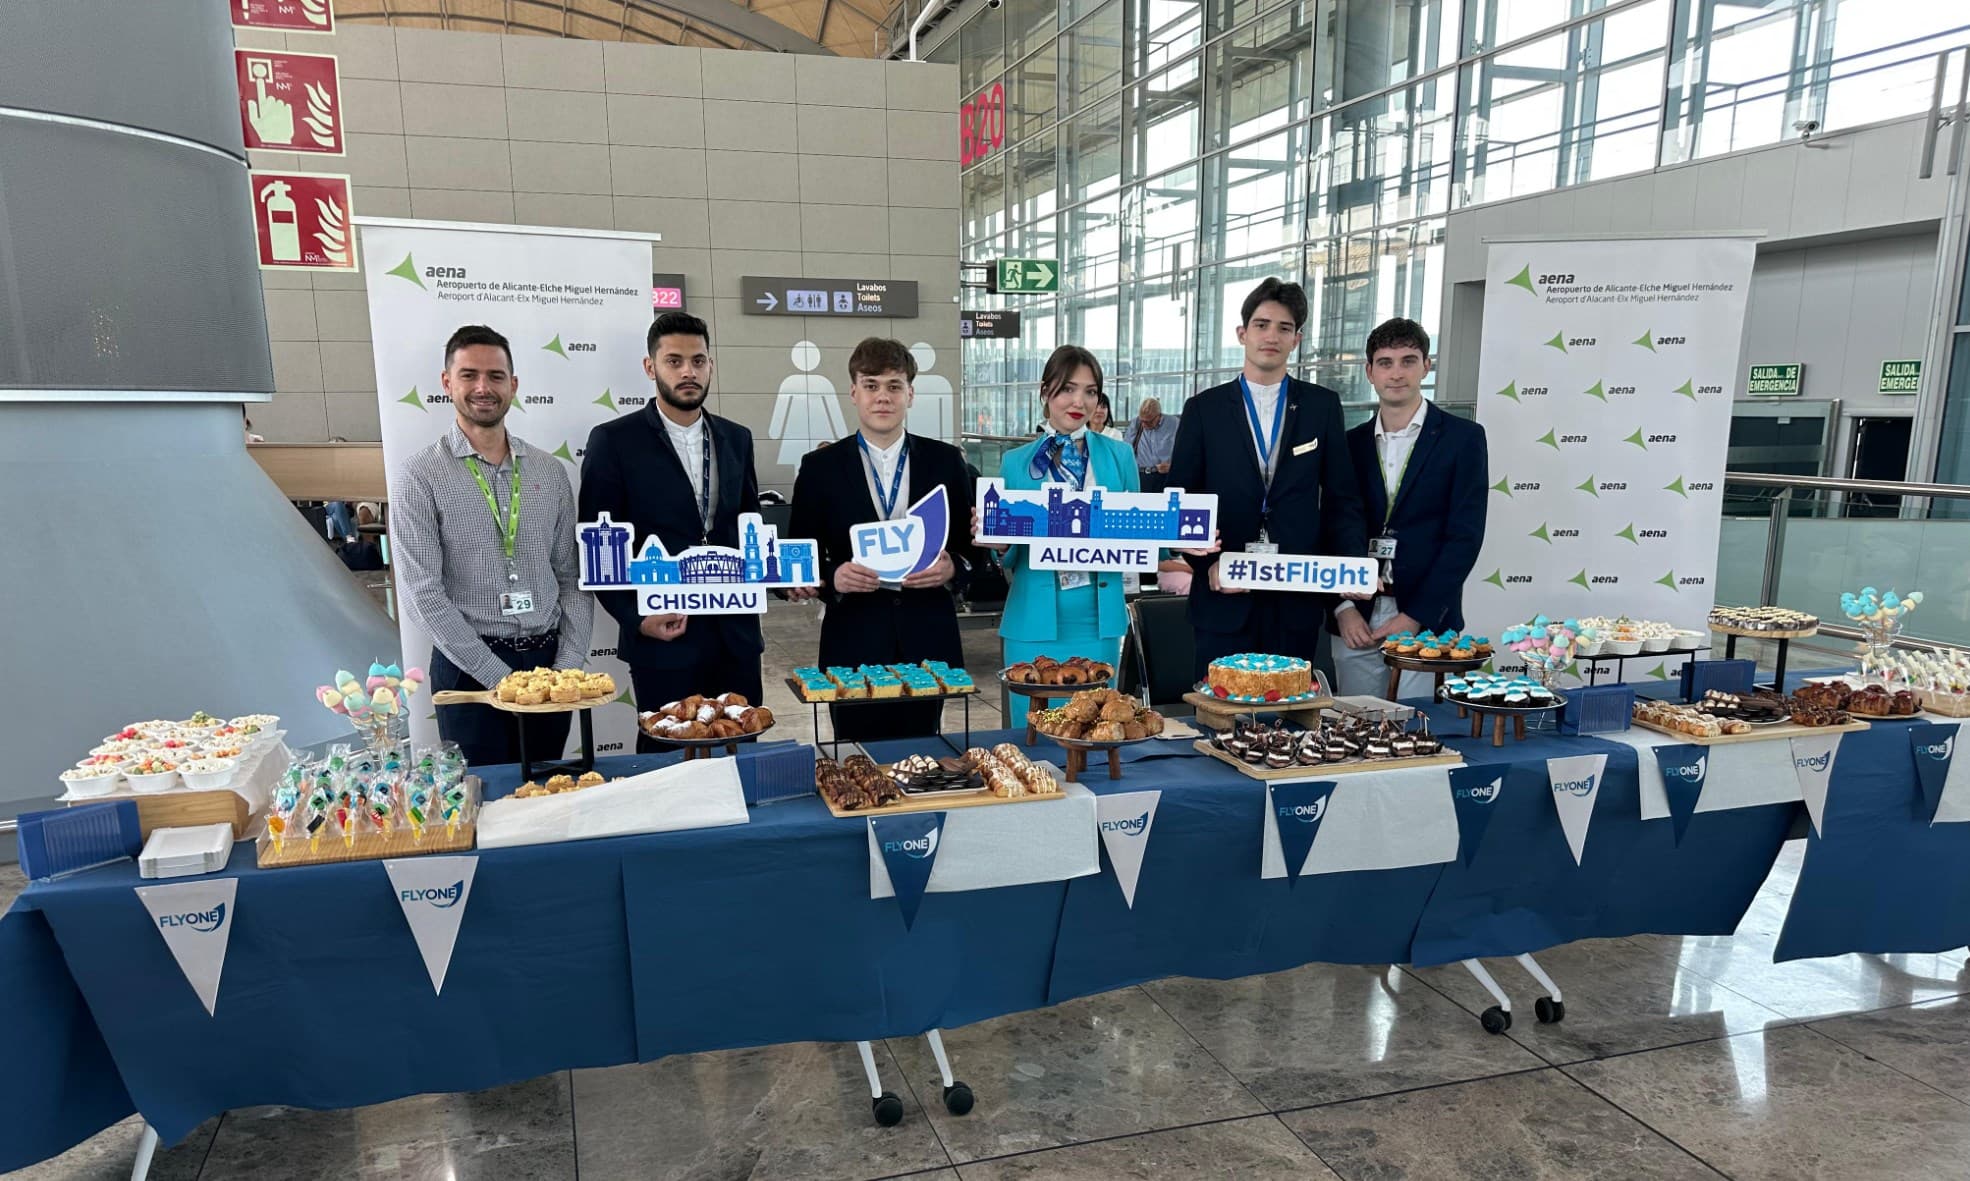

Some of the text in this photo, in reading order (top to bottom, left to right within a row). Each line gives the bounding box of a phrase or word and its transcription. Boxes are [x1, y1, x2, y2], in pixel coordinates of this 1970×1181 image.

[961, 83, 1004, 167] B20
[425, 266, 467, 279] aena
[1538, 273, 1576, 285] aena
[436, 279, 639, 297] Aeropuerto de Alicante-Elche Miguel Hernández
[856, 283, 887, 292] Lavabos
[1546, 282, 1734, 295] Aeropuerto de Alicante-Elche Miguel Hernández
[437, 291, 474, 301] Aeroport
[531, 293, 559, 305] Miguel
[560, 294, 604, 306] Hernández
[857, 293, 881, 302] Toilets
[1545, 295, 1579, 305] Aeroport
[1630, 293, 1656, 304] Miguel
[1657, 292, 1700, 302] Hernández
[857, 303, 882, 313] Aseos
[975, 312, 1002, 320] Lavabos
[1568, 336, 1596, 346] aena
[1657, 335, 1686, 346] aena
[567, 341, 597, 352] aena
[1752, 367, 1797, 380] SALIDA DE
[1884, 364, 1915, 377] SALIDA
[1608, 385, 1636, 395] aena
[1697, 385, 1722, 395] aena
[1749, 379, 1796, 391] EMERGENCIA
[1521, 386, 1549, 396] aena
[524, 394, 554, 404] aena
[618, 396, 645, 405] aena
[1560, 434, 1588, 443] aena
[1648, 433, 1677, 443] aena
[1513, 481, 1541, 491] aena
[1599, 481, 1627, 491] aena
[1688, 481, 1714, 491] aena
[1552, 528, 1580, 537] aena
[1639, 528, 1667, 538] aena
[857, 523, 914, 557] FLY
[1040, 547, 1149, 565] ALICANTE
[1381, 546, 1393, 556] 27
[1227, 559, 1369, 590] #1stFlight
[1505, 574, 1533, 584] aena
[1591, 574, 1619, 584] aena
[1679, 575, 1705, 585] aena
[516, 599, 531, 610] 29
[646, 592, 757, 610] CHISINAU
[590, 647, 618, 657] aena
[1498, 664, 1524, 673] aena
[596, 742, 623, 752] aena
[1915, 744, 1946, 754] FLYONE
[1796, 756, 1826, 769] FLYONE
[1665, 765, 1699, 777] FLYONE
[1554, 780, 1589, 792] FLYONE
[1456, 786, 1493, 799] FLYONE
[1279, 804, 1317, 817] FLYONE
[1102, 818, 1143, 832] FLYONE
[884, 838, 928, 853] FLYONE
[401, 887, 456, 901] FLYONE
[159, 910, 218, 928] FLYONE
